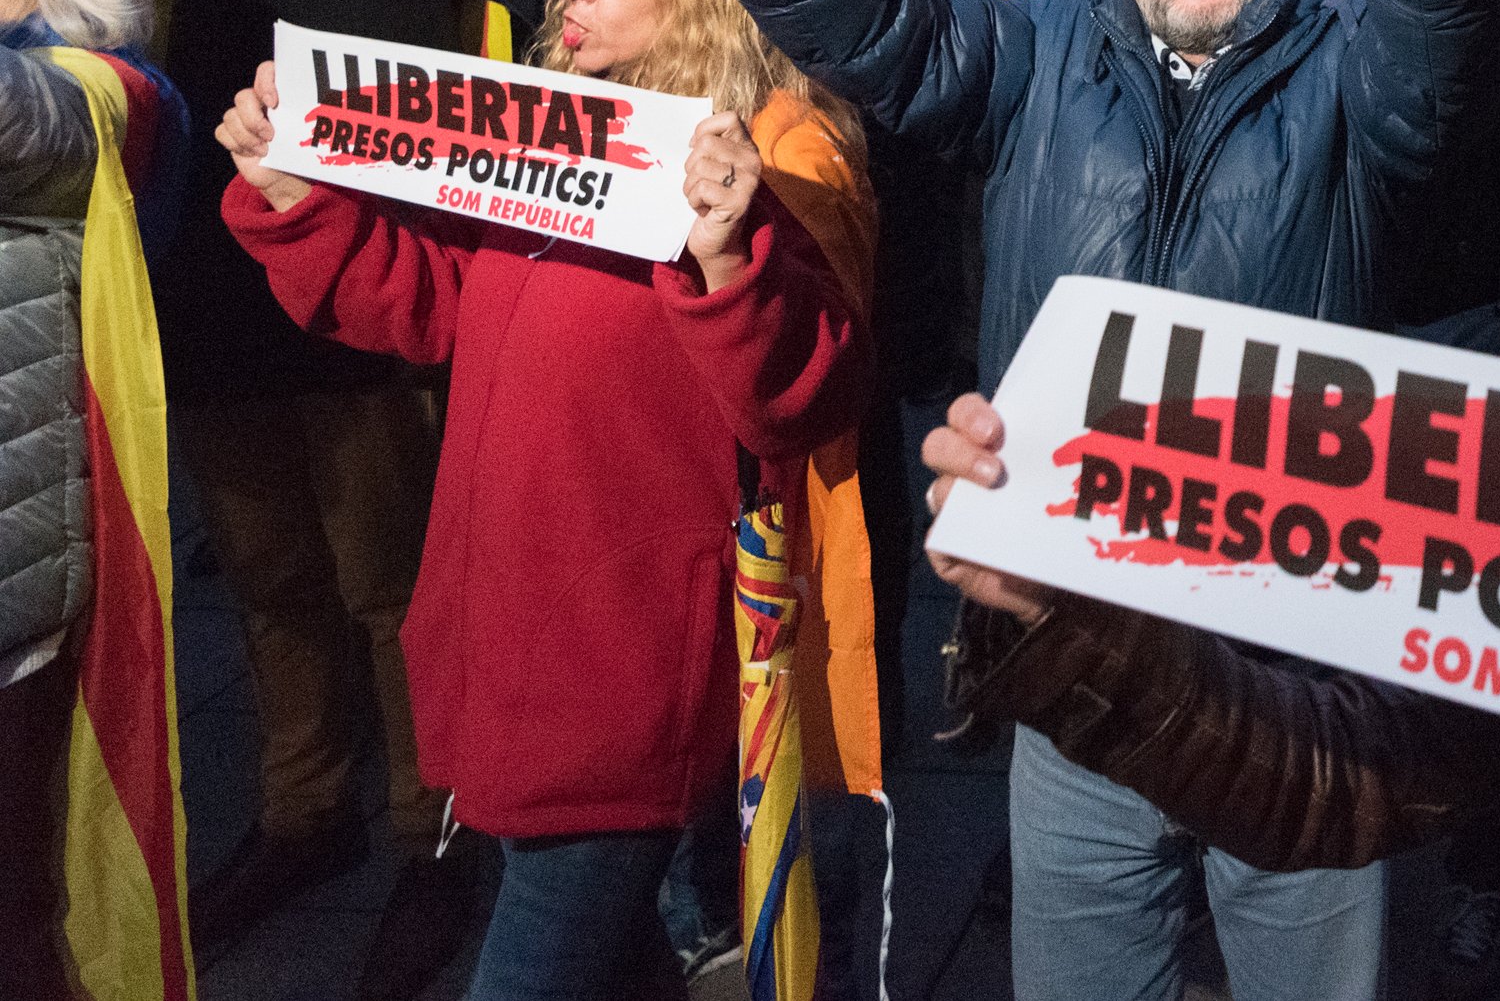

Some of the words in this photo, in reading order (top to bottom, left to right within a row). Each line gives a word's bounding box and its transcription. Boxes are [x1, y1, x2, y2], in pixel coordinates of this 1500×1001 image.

[312, 49, 616, 161] LLIBERTAT
[310, 115, 435, 171] PRESOS
[446, 145, 614, 210] POLÍTICS!
[436, 184, 482, 213] SOM
[488, 196, 595, 240] REPÚBLICA
[1076, 454, 1381, 593] PRESOS
